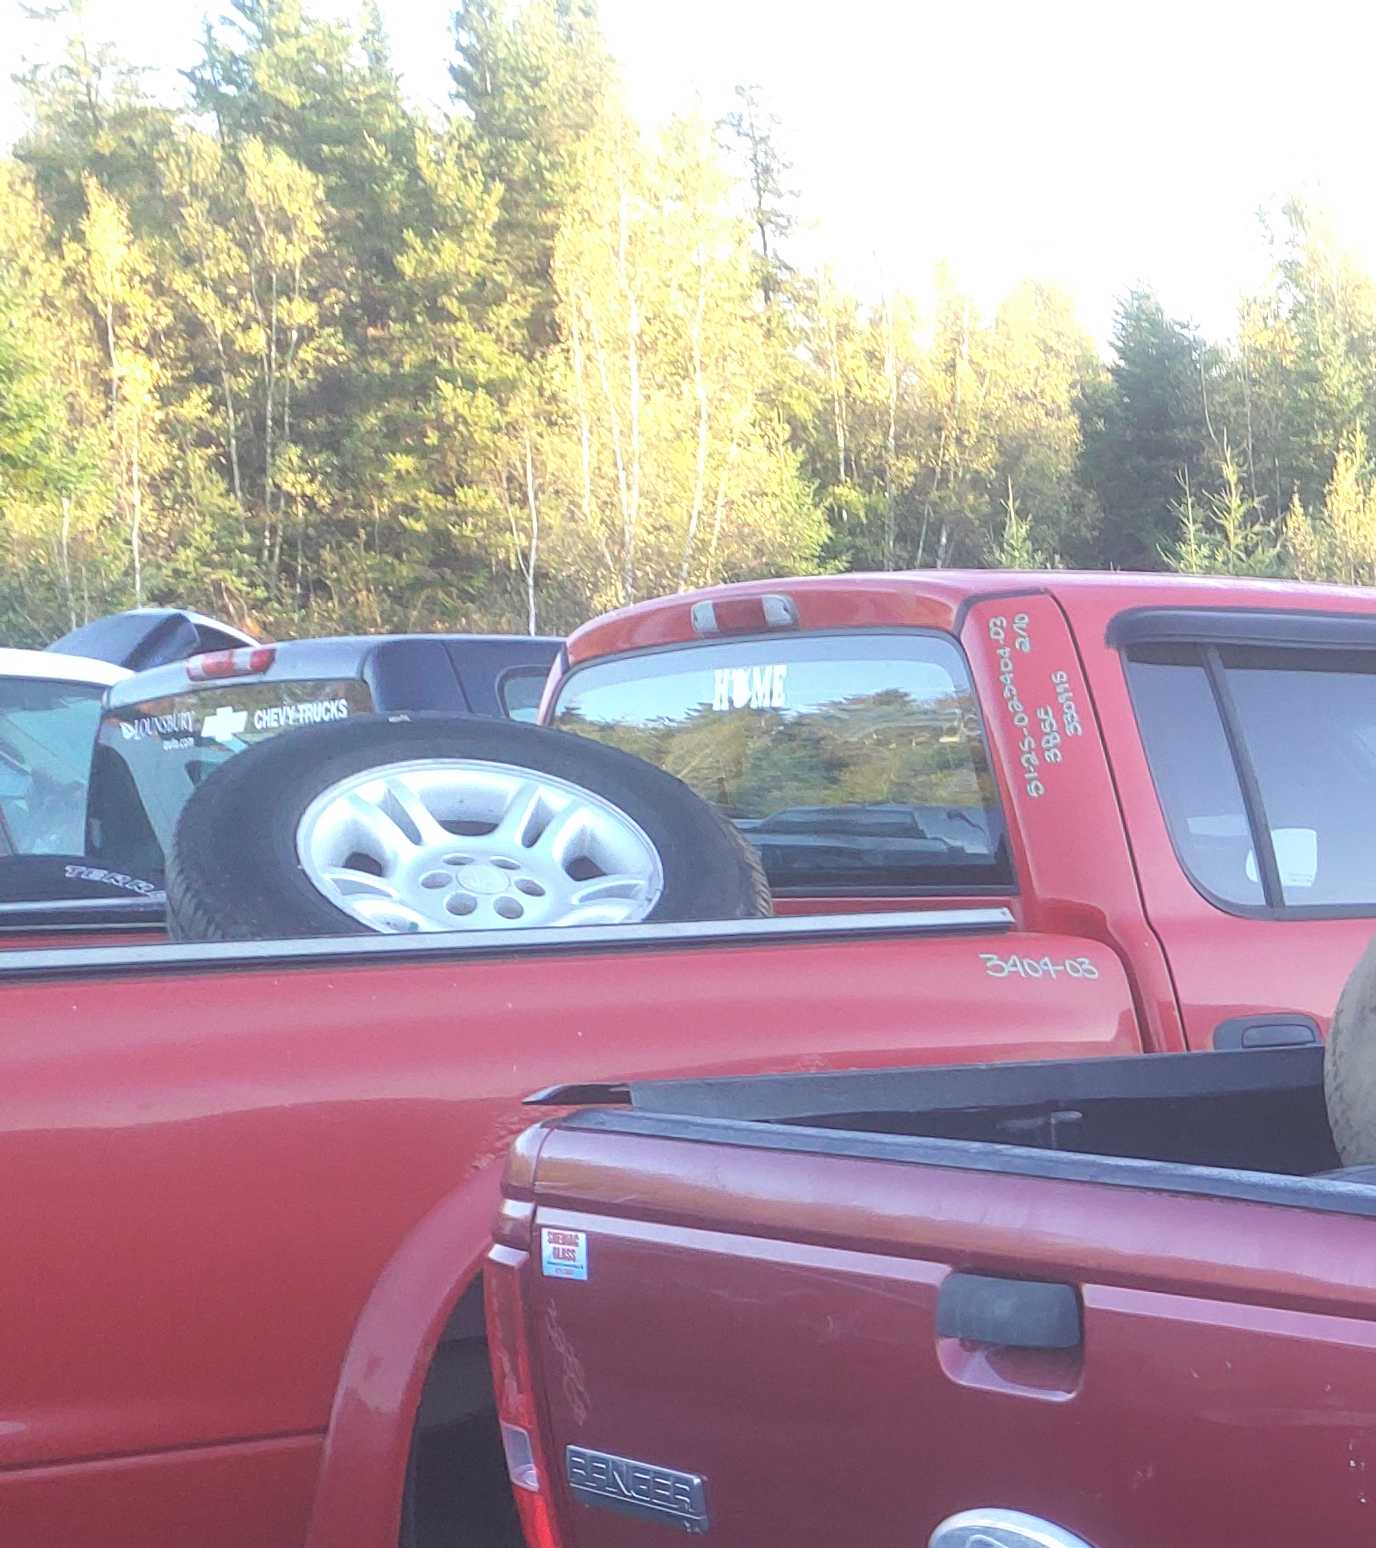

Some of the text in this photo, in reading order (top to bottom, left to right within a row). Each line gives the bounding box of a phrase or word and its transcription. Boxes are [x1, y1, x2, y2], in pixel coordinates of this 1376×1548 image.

[254, 698, 348, 730] CHEVY TRUCKS
[570, 1455, 694, 1515] RANGER
